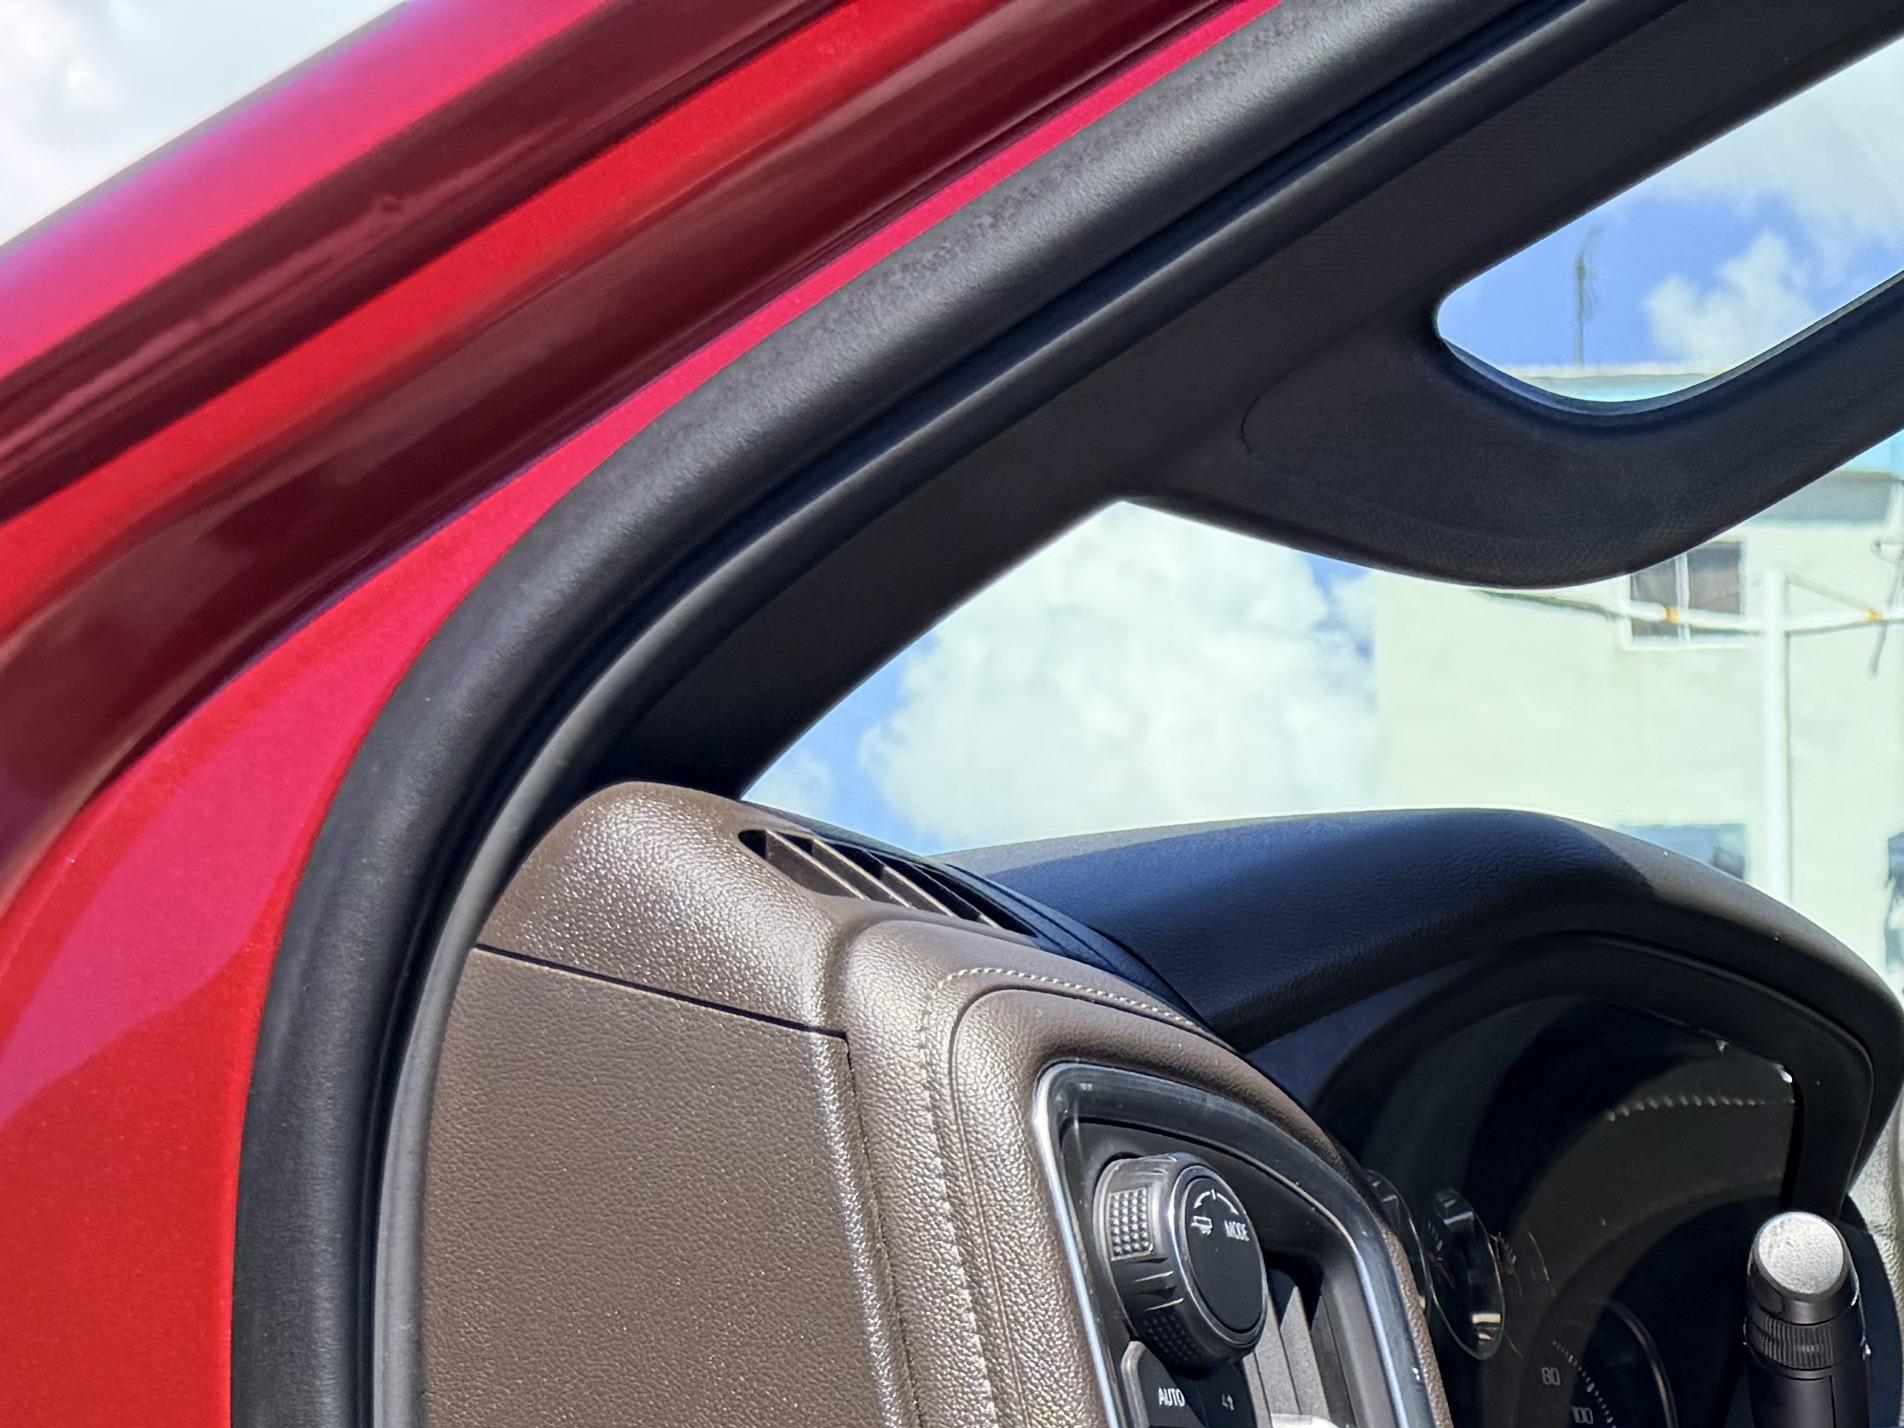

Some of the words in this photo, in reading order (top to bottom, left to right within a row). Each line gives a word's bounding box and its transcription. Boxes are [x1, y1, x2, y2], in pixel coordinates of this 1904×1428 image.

[1224, 1219, 1250, 1242] MODE
[1541, 1366, 1561, 1386] 80
[1158, 1387, 1186, 1407] AUTO
[1572, 1406, 1594, 1425] 100
